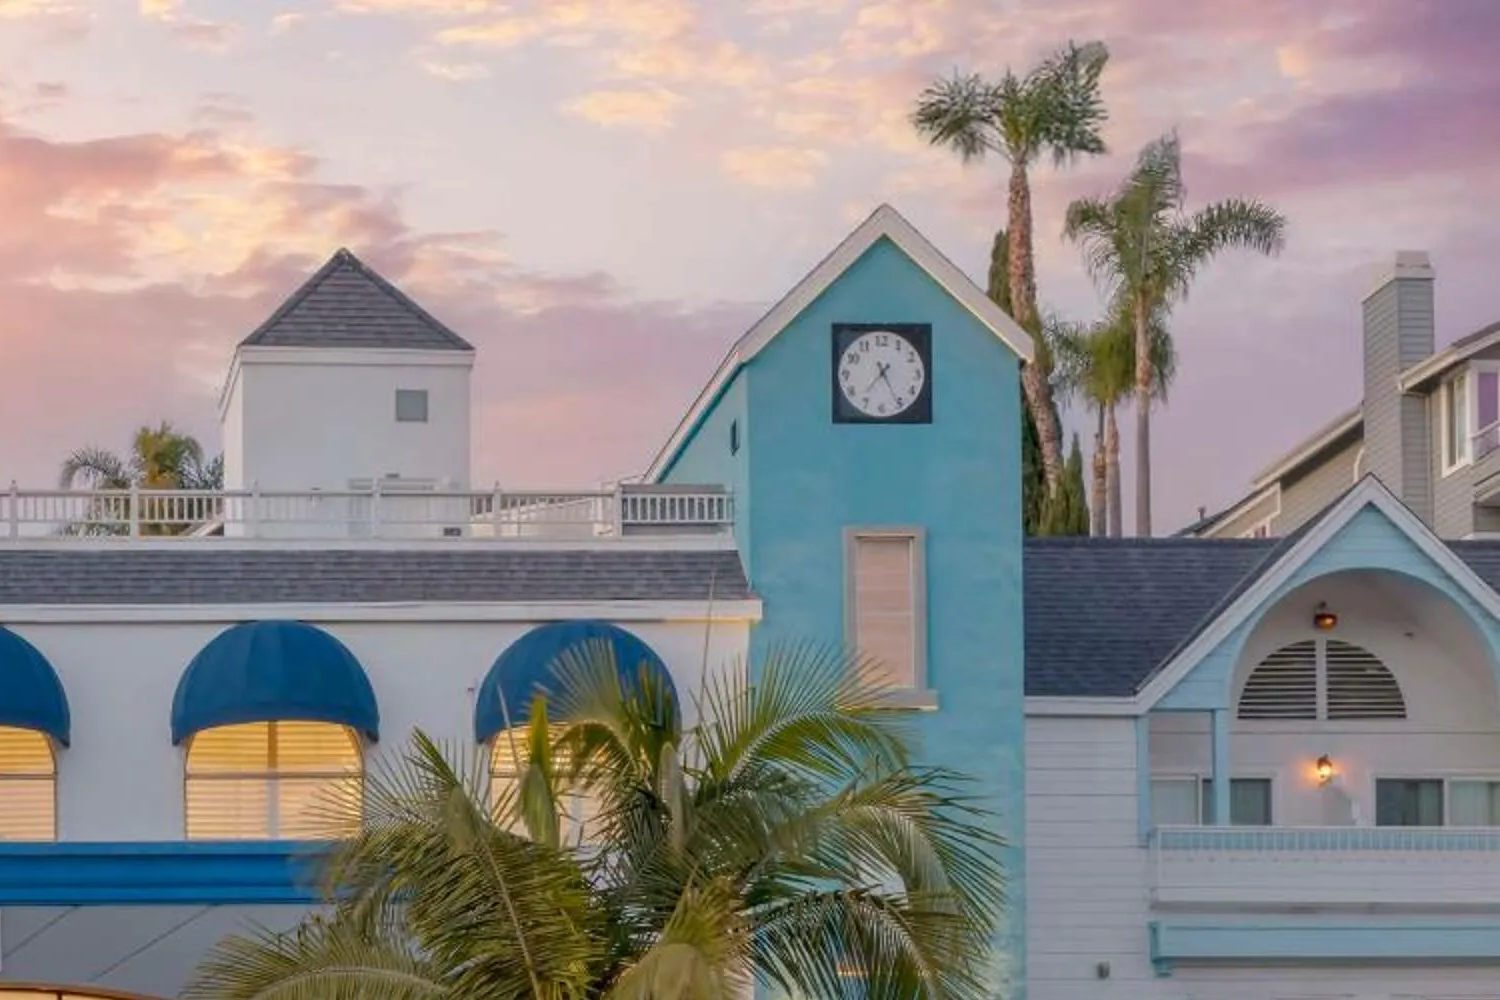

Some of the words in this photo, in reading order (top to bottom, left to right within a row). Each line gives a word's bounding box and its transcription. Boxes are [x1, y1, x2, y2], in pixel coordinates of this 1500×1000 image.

[859, 340, 870, 353] 11
[875, 335, 888, 347] 12
[895, 339, 901, 350] 1
[847, 352, 860, 365] 10
[907, 350, 915, 363] 2
[842, 369, 850, 381] 9
[862, 397, 869, 410] 7
[895, 396, 904, 409] 5
